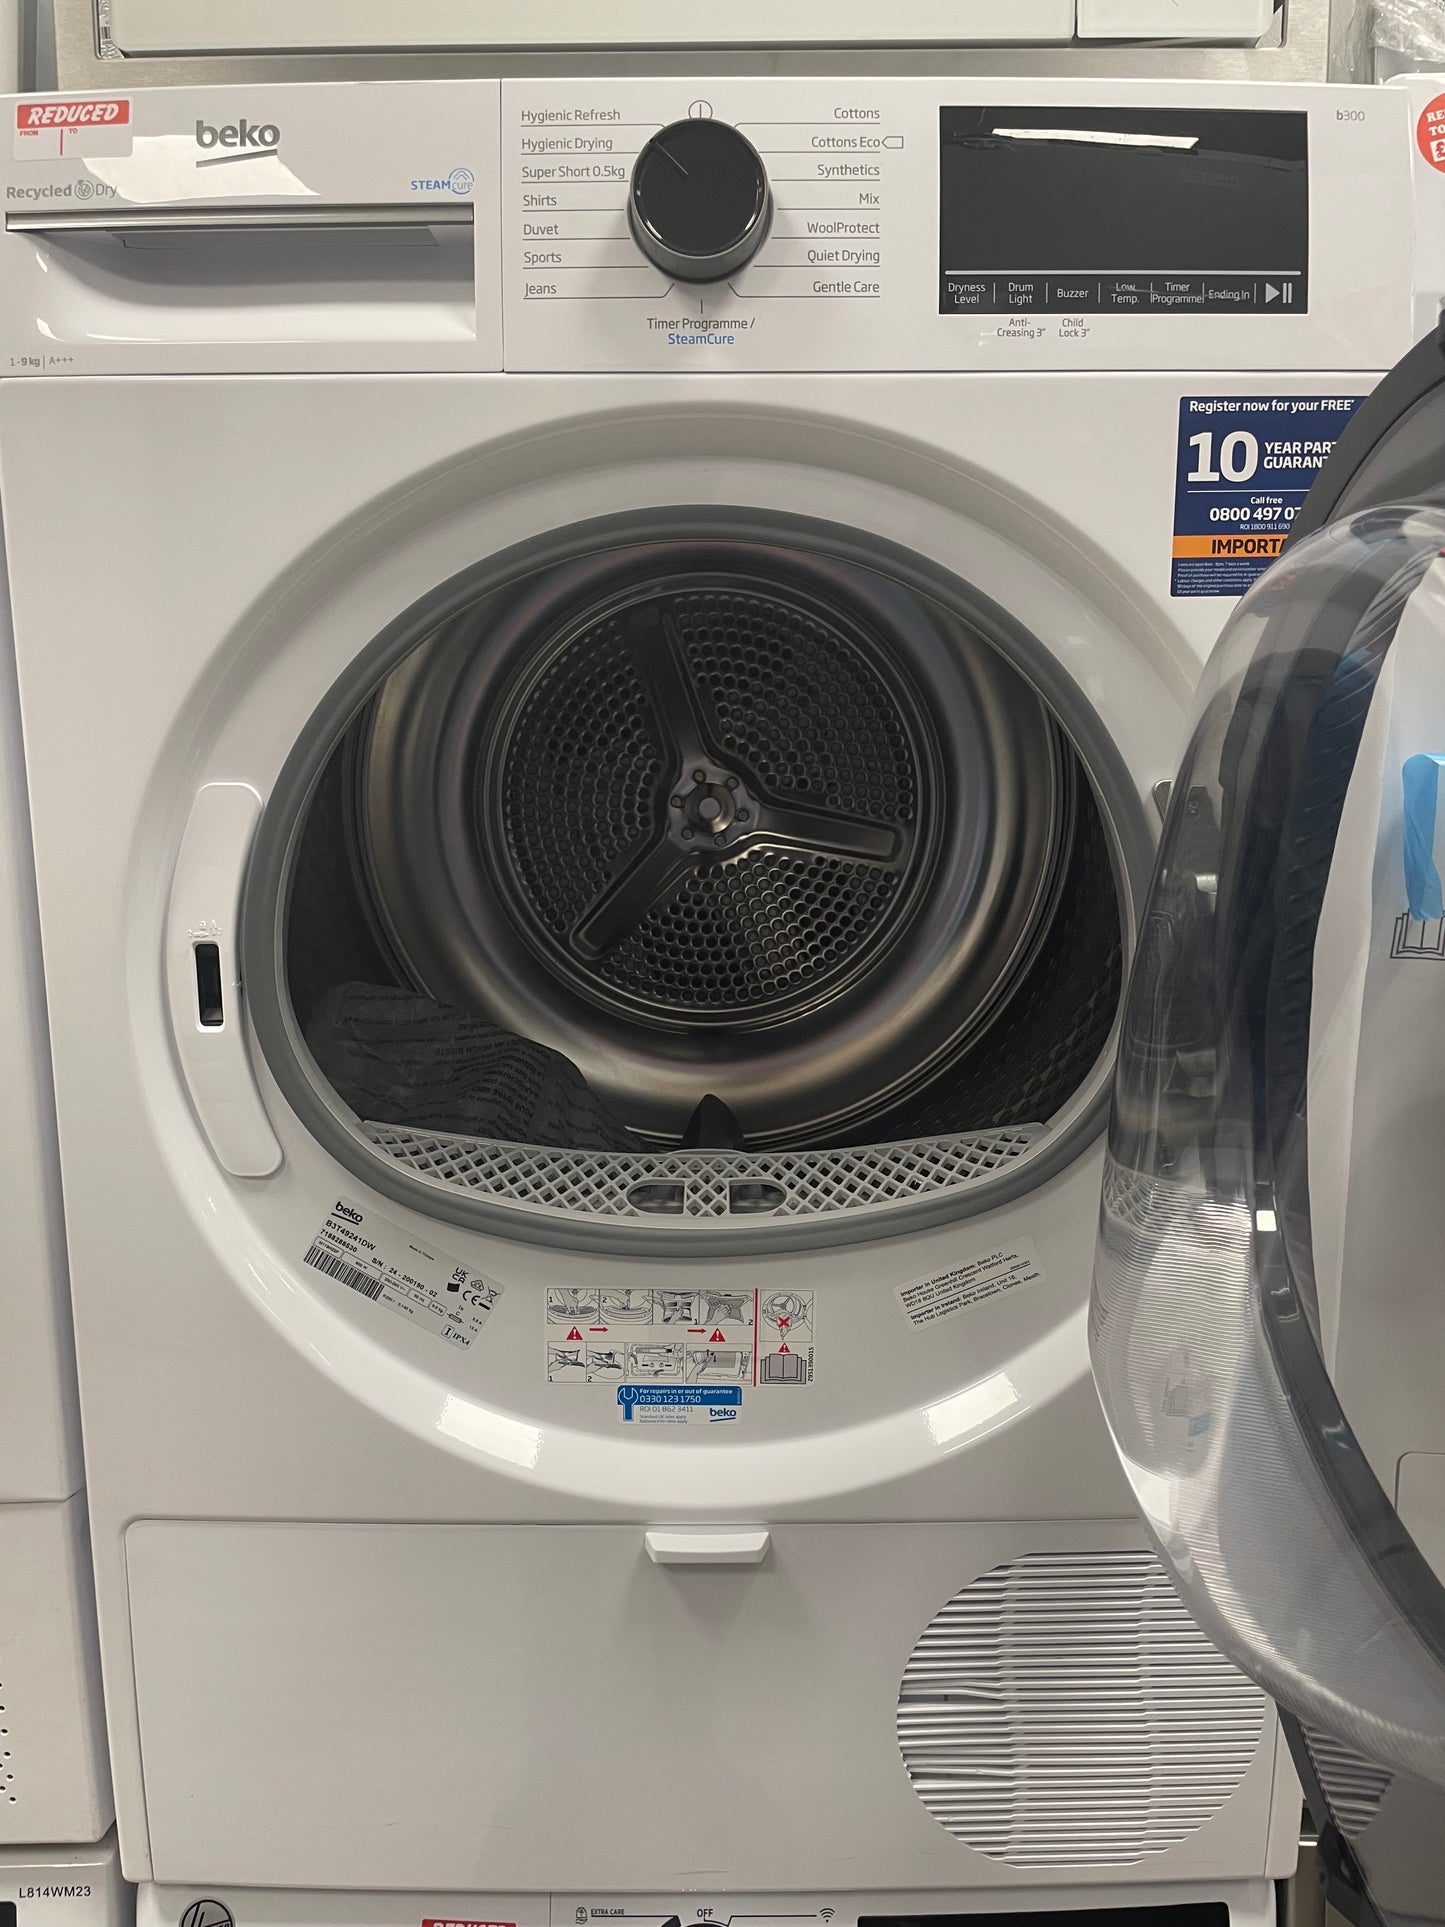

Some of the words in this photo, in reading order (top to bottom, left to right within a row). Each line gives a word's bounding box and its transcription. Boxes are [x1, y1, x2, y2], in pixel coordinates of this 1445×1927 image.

[28, 104, 119, 125] REDUCED
[521, 109, 573, 123] Hygienic
[575, 109, 621, 121] Refresh
[834, 108, 880, 119] Cottons
[1336, 110, 1365, 121] b300
[196, 119, 281, 149] beko
[521, 137, 572, 151] Hygienic
[575, 137, 613, 151] Drying
[811, 136, 857, 148] Cottons
[860, 136, 880, 148] Eco
[522, 167, 555, 181] Super
[559, 166, 591, 178] Short
[593, 165, 626, 180] 0.5kg
[817, 164, 880, 178] Synthetics
[6, 184, 72, 200] Recycled
[96, 183, 117, 198] Dry
[523, 195, 557, 206] Shirts
[859, 193, 880, 205] Mix
[523, 224, 559, 236] Duvet
[807, 222, 880, 234] WoolProtect
[524, 251, 562, 264] Sports
[807, 250, 839, 263] Quiet
[842, 250, 880, 264] Drying
[525, 283, 557, 295] Jeans
[812, 280, 851, 293] Gentle
[854, 281, 880, 293] Care
[948, 283, 986, 294] Dryness
[1008, 283, 1034, 292] Drum
[1116, 283, 1136, 292] Low
[1165, 282, 1190, 292] Timer
[954, 294, 980, 304] Level
[1057, 289, 1089, 298] Buzzer
[1111, 294, 1140, 304] Temp.
[1208, 290, 1240, 301] Ending
[1241, 290, 1250, 299] In
[1009, 294, 1033, 306] Light
[1153, 294, 1202, 306] Programme
[647, 318, 680, 330] Timer
[682, 318, 748, 333] Programme
[1009, 318, 1031, 327] Anti-
[1062, 318, 1084, 327] Child
[667, 333, 735, 345] SteamCure
[997, 328, 1035, 339] Creasing
[1059, 328, 1079, 338] Lock
[49, 356, 74, 365] A+++
[1189, 401, 1241, 414] Register
[1243, 402, 1270, 411] now
[1271, 400, 1289, 411] for
[1291, 402, 1319, 414] your
[1265, 442, 1301, 454] YEAR
[1187, 430, 1259, 483] 10
[1209, 507, 1250, 521] 0800
[1253, 507, 1281, 521] 497
[335, 1201, 363, 1222] beko
[326, 1219, 376, 1251] B3T49241DW
[372, 1258, 383, 1267] S/N
[388, 1267, 397, 1275] 24
[429, 1289, 438, 1297] 02
[900, 1285, 924, 1296] Importer
[930, 1274, 949, 1284] United
[935, 1286, 952, 1295] United
[953, 1277, 975, 1289] Kingdom
[917, 1287, 933, 1296] House
[910, 1308, 933, 1320] Importer
[453, 1332, 470, 1345] IPX4
[640, 1395, 661, 1403] 0330
[663, 1395, 678, 1403] 123
[680, 1395, 702, 1403] 1750
[709, 1408, 737, 1417] beko
[19, 1886, 91, 1898] L814WM23
[697, 1909, 713, 1917] OFF
